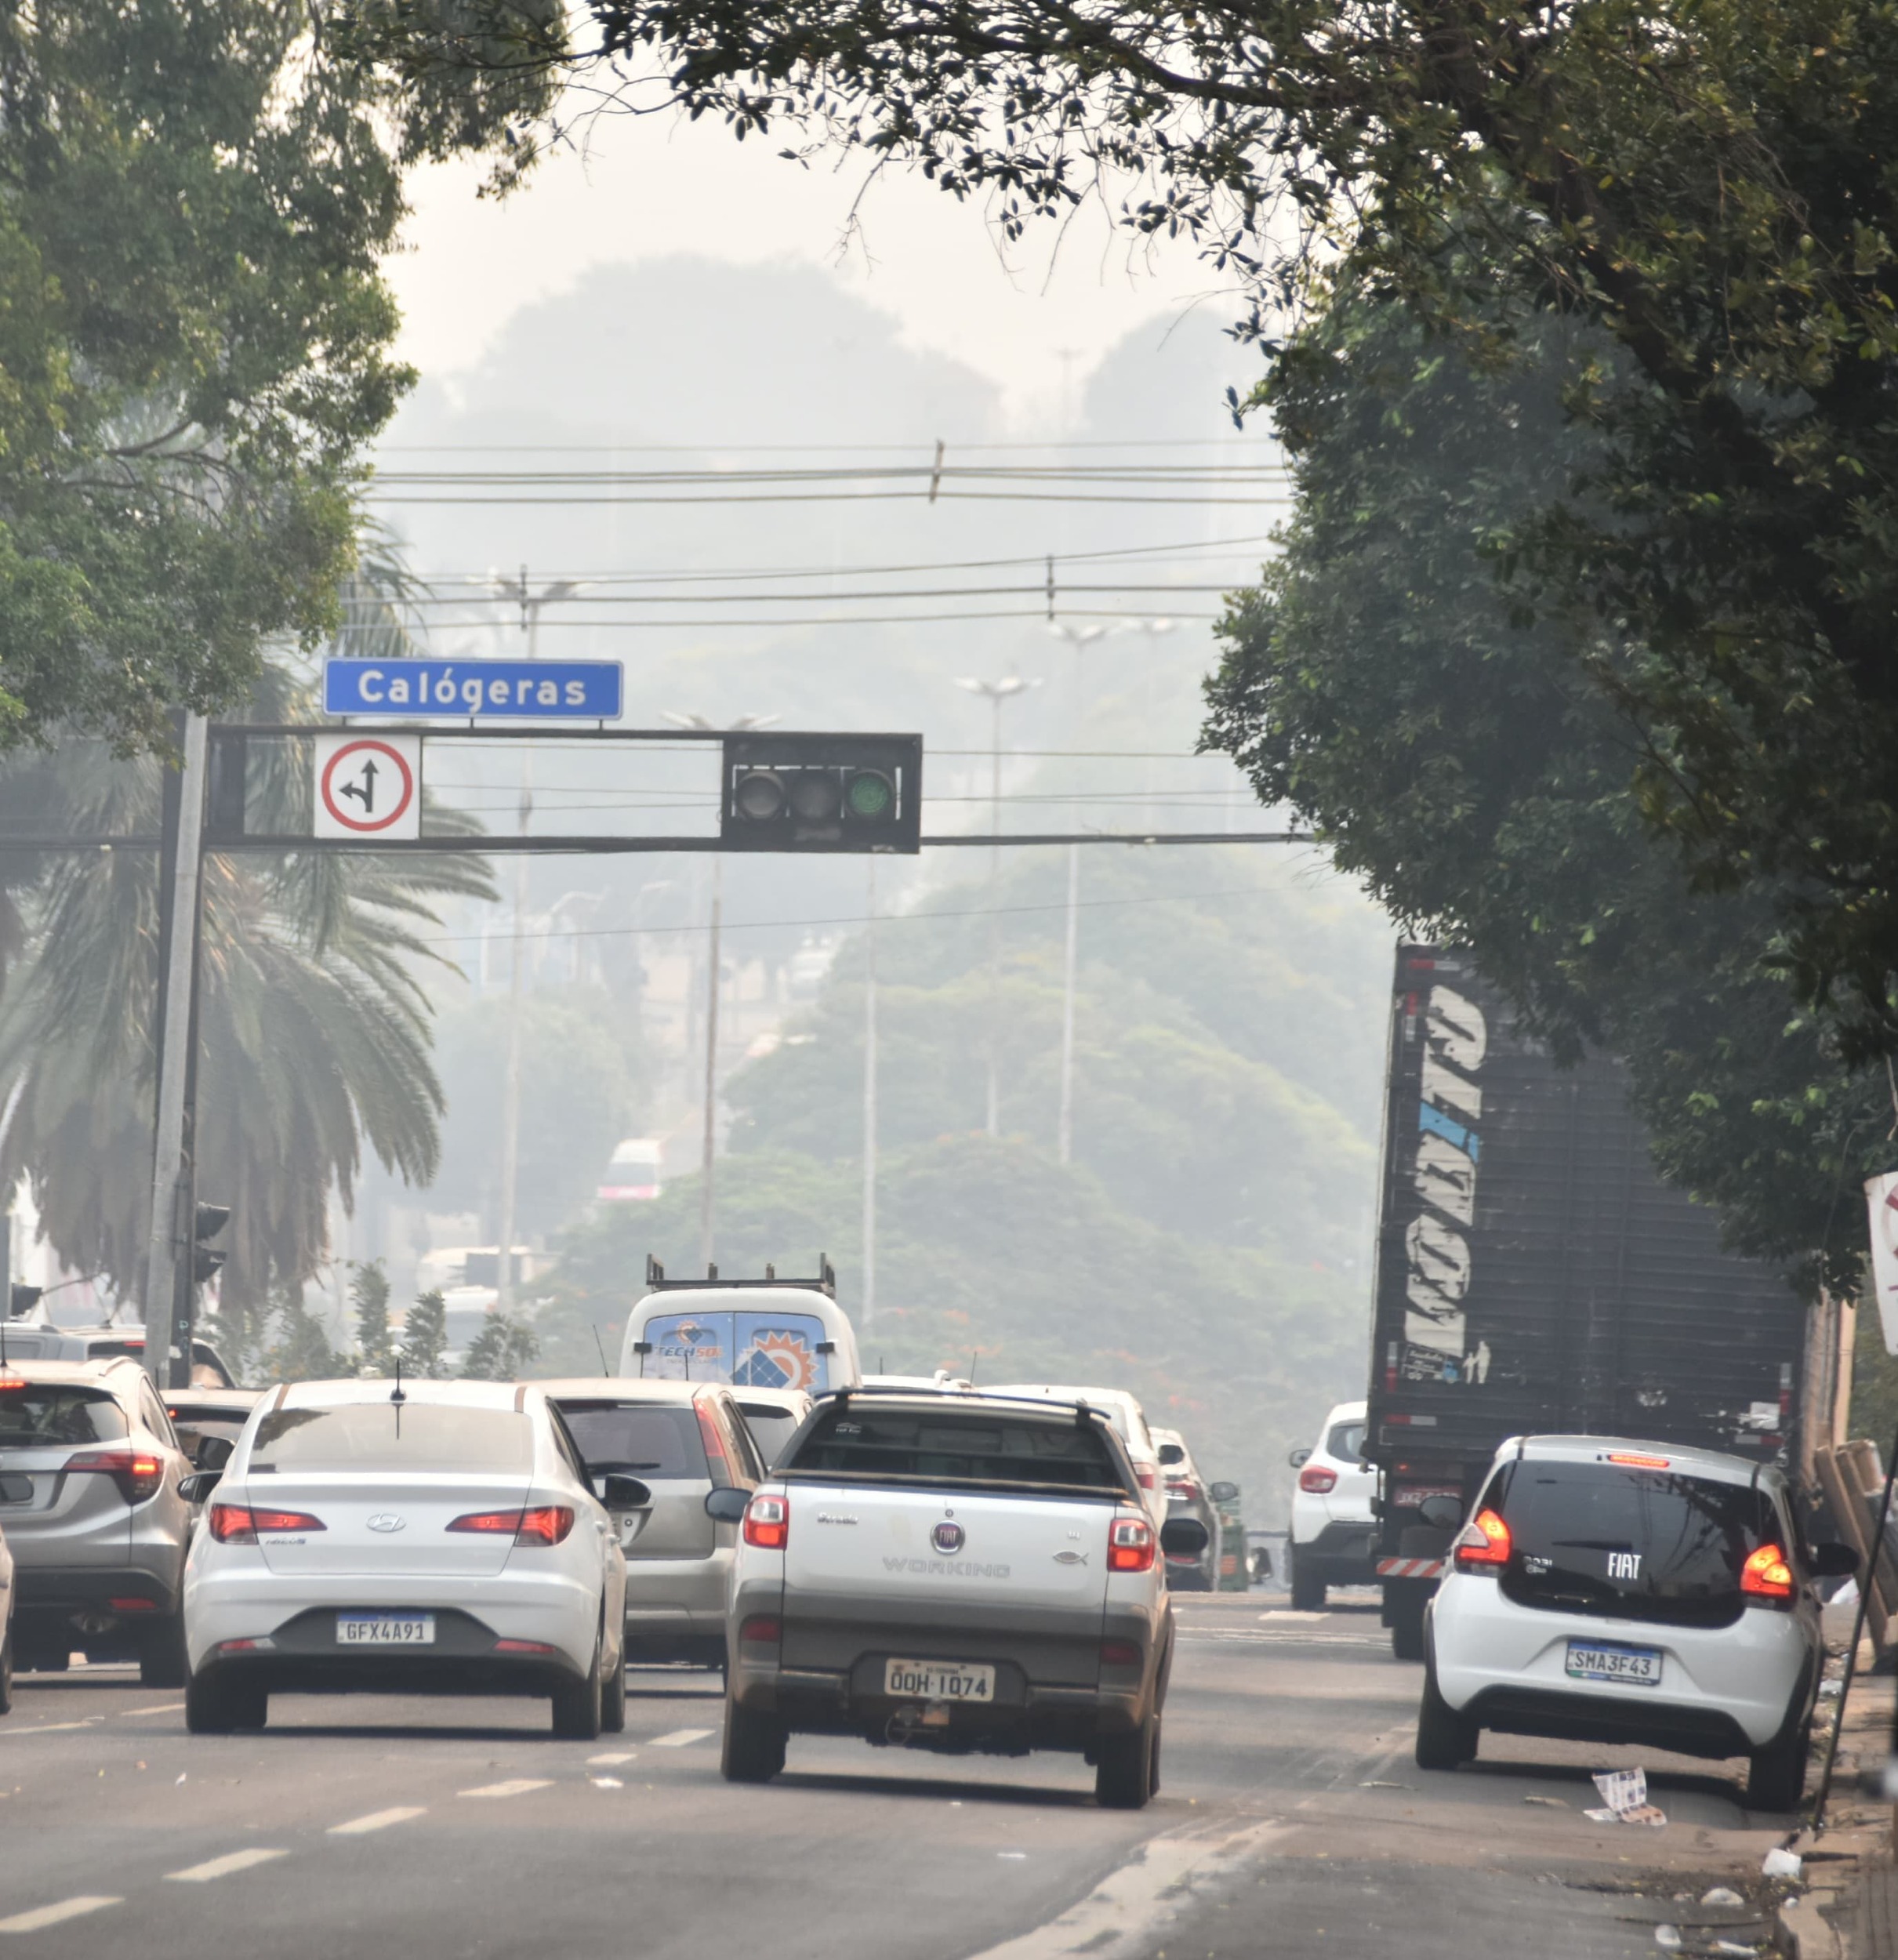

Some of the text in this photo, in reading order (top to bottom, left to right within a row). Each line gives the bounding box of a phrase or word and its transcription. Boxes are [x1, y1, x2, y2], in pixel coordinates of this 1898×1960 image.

[358, 667, 586, 713] Calógeras
[939, 1530, 959, 1544] FIAT
[882, 1556, 1011, 1578] WORKING
[1608, 1552, 1642, 1579] FIAT
[347, 1622, 425, 1641] GFX4A91
[1574, 1650, 1652, 1676] SMA3F43
